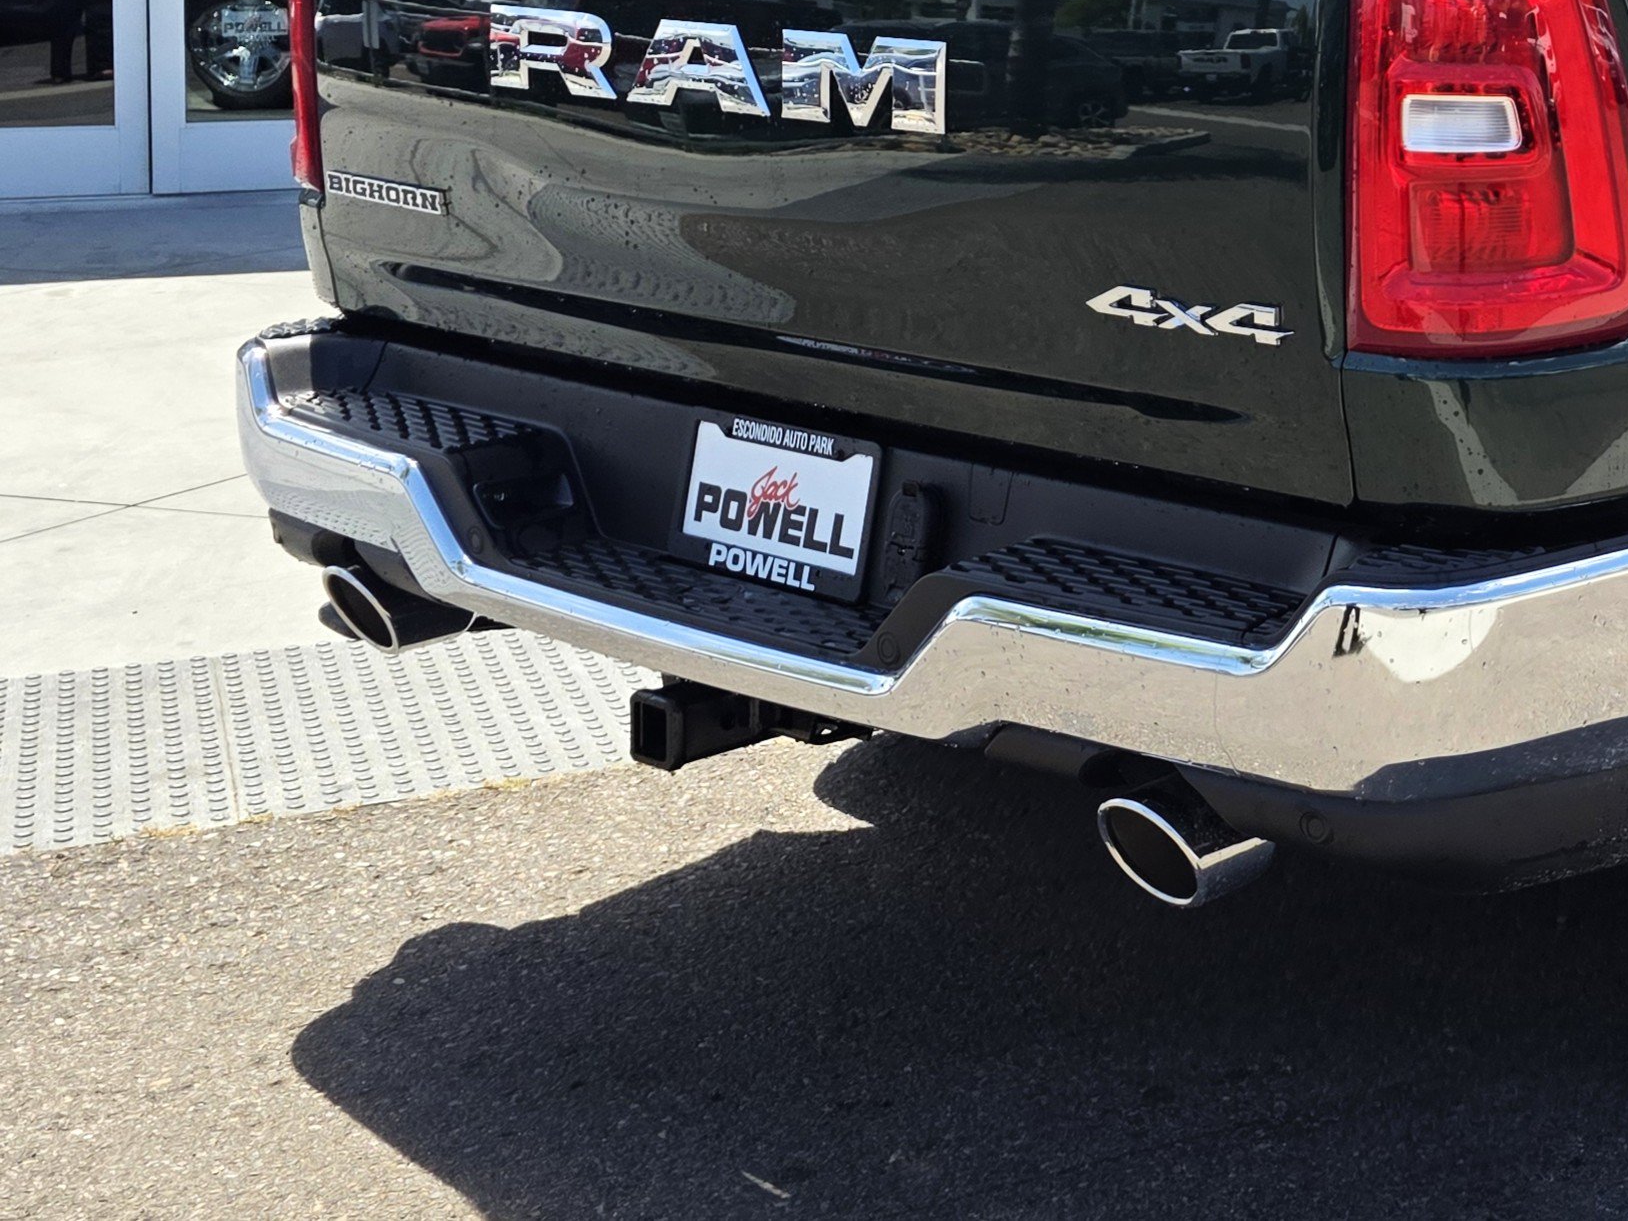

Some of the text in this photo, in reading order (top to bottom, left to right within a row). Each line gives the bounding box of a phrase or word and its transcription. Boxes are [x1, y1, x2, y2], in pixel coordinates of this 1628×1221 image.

[490, 4, 947, 135] RAM
[327, 172, 440, 212] BIGHORN
[1085, 285, 1295, 346] 4x4
[732, 418, 835, 456] ESCONDIDO AUTO PARK
[747, 465, 800, 520] Jack
[694, 481, 855, 560] POWELL
[708, 542, 816, 592] POWELL
